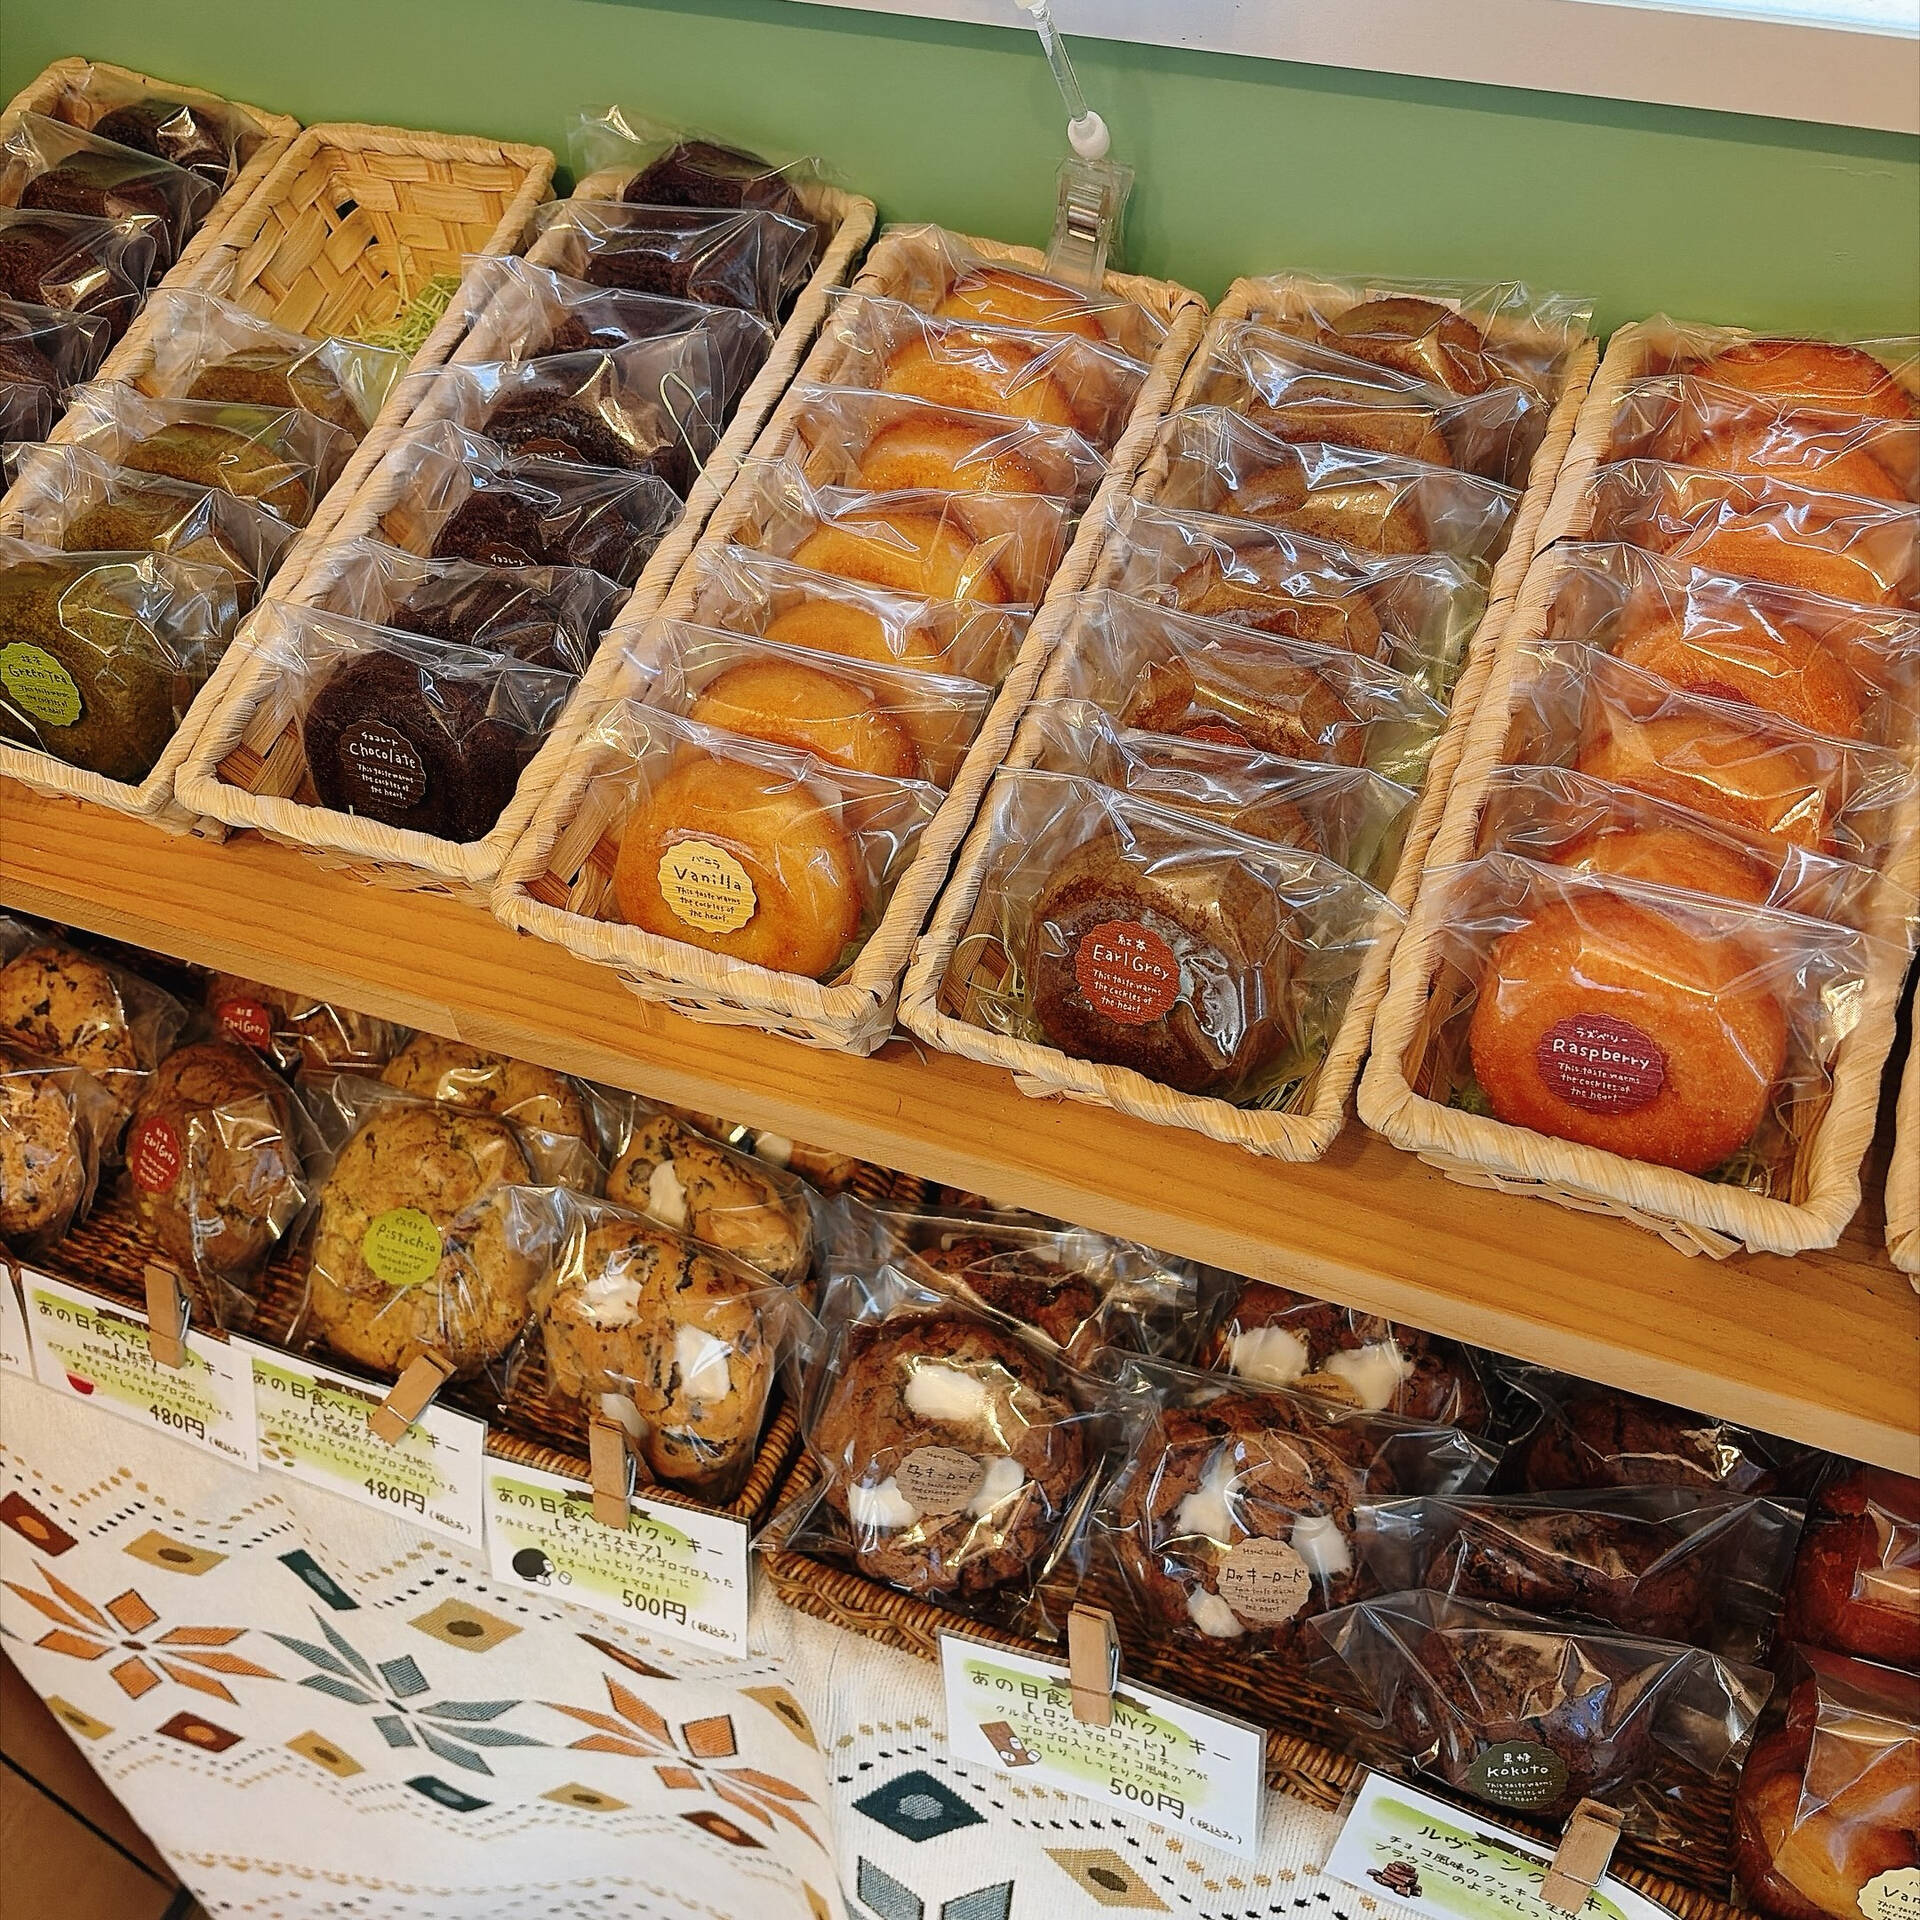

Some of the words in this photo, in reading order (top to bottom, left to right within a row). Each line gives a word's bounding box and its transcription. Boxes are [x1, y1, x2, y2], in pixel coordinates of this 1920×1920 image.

[8, 664, 45, 679] Green
[350, 742, 415, 768] Chocolate
[692, 856, 720, 869] バニラ
[674, 865, 741, 890] Vanilla
[676, 886, 693, 896] This
[696, 889, 715, 900] taste
[717, 895, 741, 905] warms
[680, 896, 692, 904] the
[695, 900, 724, 911] cockles
[727, 905, 734, 914] of
[1093, 944, 1128, 966] Earl
[1132, 956, 1169, 980] Grey
[1093, 969, 1110, 981] This
[1112, 974, 1133, 988] taste
[1136, 984, 1162, 997] warms
[1094, 981, 1107, 991] the
[1110, 987, 1140, 1003] cockles
[1143, 997, 1152, 1005] of
[1101, 996, 1114, 1006] the
[1576, 1027, 1628, 1043] ラズベリー
[1552, 1039, 1650, 1070] Raspberry
[1558, 1062, 1579, 1073] This
[1582, 1066, 1607, 1079] taste
[1609, 1072, 1640, 1085] warms
[1561, 1073, 1576, 1083] the
[1579, 1079, 1618, 1091] cockles
[1620, 1085, 1630, 1093] of
[1571, 1086, 1586, 1096] the
[150, 1404, 205, 1440] 480円
[364, 1478, 425, 1514] 480円
[622, 1589, 687, 1625] 500円
[1109, 1777, 1185, 1820] 500円
